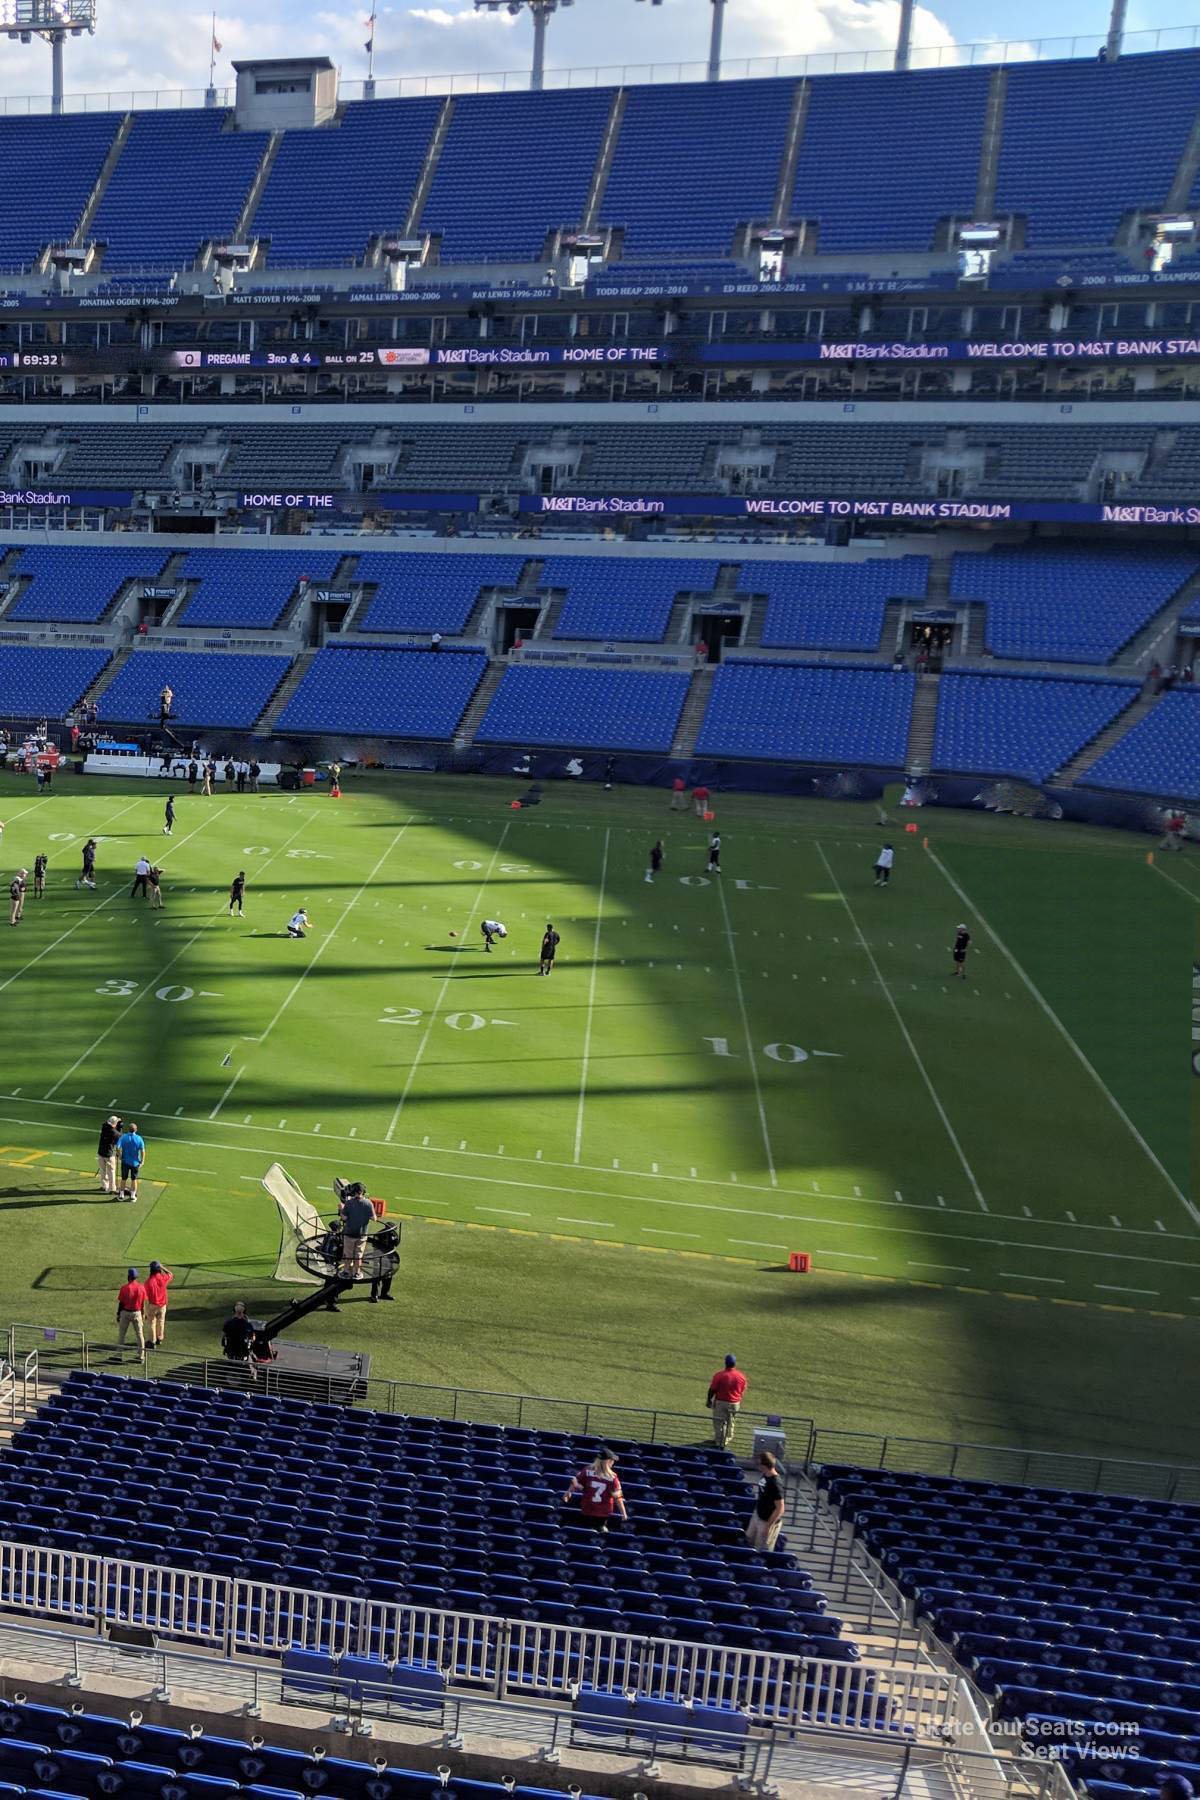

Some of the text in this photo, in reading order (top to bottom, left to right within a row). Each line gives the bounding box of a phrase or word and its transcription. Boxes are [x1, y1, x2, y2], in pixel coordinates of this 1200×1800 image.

[1114, 274, 1150, 283] WORLD
[376, 293, 399, 301] LEWIS
[596, 288, 618, 296] TODD
[620, 287, 642, 295] HEAP
[563, 348, 658, 360] HOME OF THE
[820, 344, 948, 358] M&T Bank Stadium
[968, 344, 1048, 356] WELCOME
[1052, 343, 1075, 356] TO
[1078, 342, 1114, 355] M&T
[1116, 341, 1164, 354] BANK
[23, 355, 58, 365] 69:32
[184, 354, 194, 365] 0
[207, 354, 250, 365] PREGAME
[267, 353, 311, 364] 3RD & 4
[325, 355, 343, 363] BALL
[359, 352, 374, 362] 25
[438, 349, 549, 362] M&T Bank Stadium
[25, 491, 70, 504] Stadium
[244, 495, 332, 506] HOME OF THE
[542, 497, 664, 512] M&T Bank Stadium
[746, 500, 1010, 518] WELCOME TO M&T BANK STADIUM
[1103, 506, 1185, 523] M&T Bank
[95, 978, 194, 1002] 30
[377, 1006, 486, 1032] 20
[702, 1036, 809, 1063] 10
[794, 1255, 808, 1270] 10
[591, 1481, 607, 1502] 7
